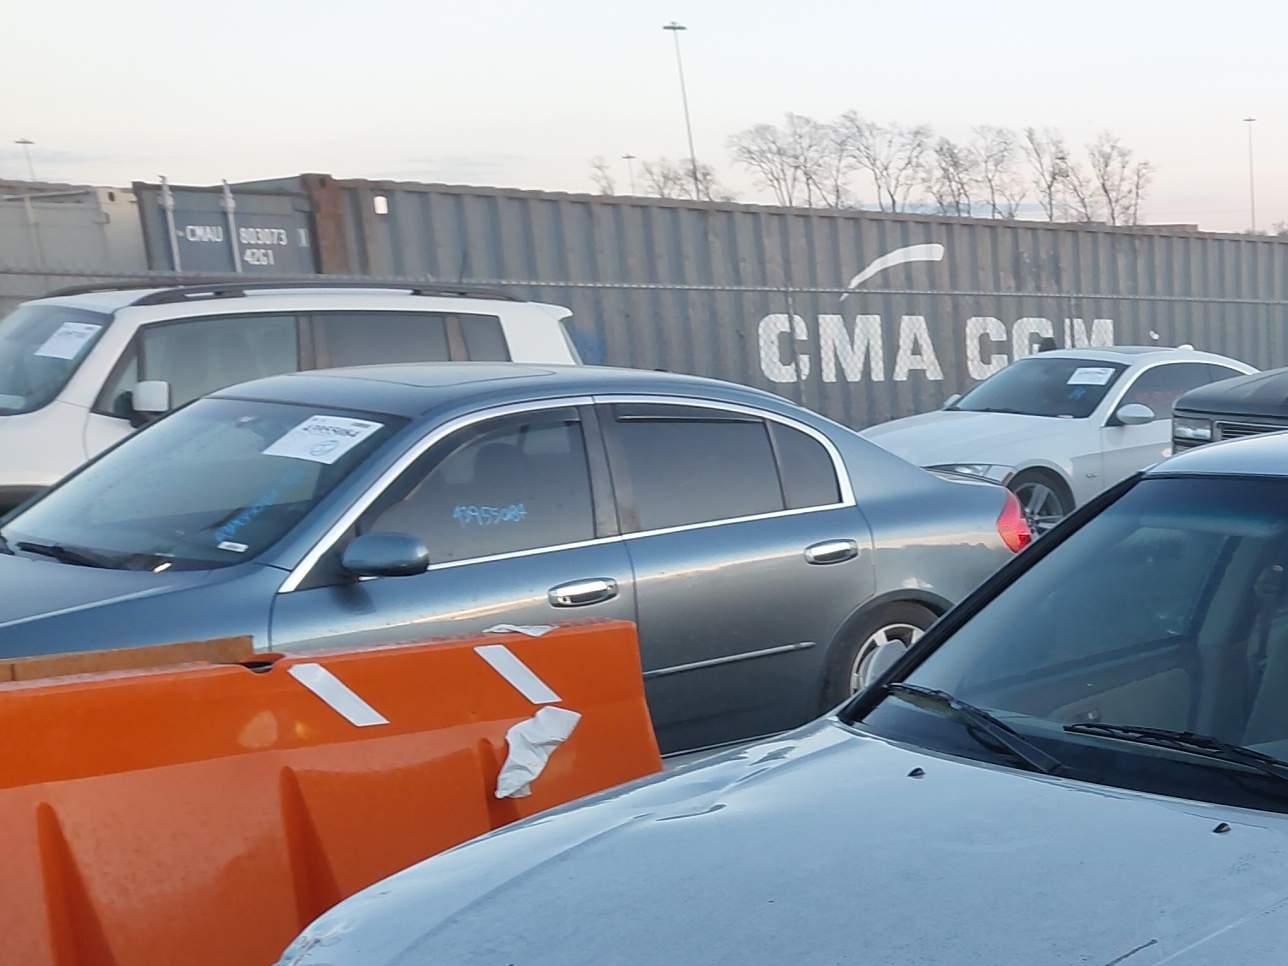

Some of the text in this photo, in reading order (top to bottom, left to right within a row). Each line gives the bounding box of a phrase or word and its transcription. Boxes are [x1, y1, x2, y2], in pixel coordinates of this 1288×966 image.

[185, 225, 224, 242] CMAU
[239, 228, 288, 246] 803073
[757, 313, 945, 383] CMA
